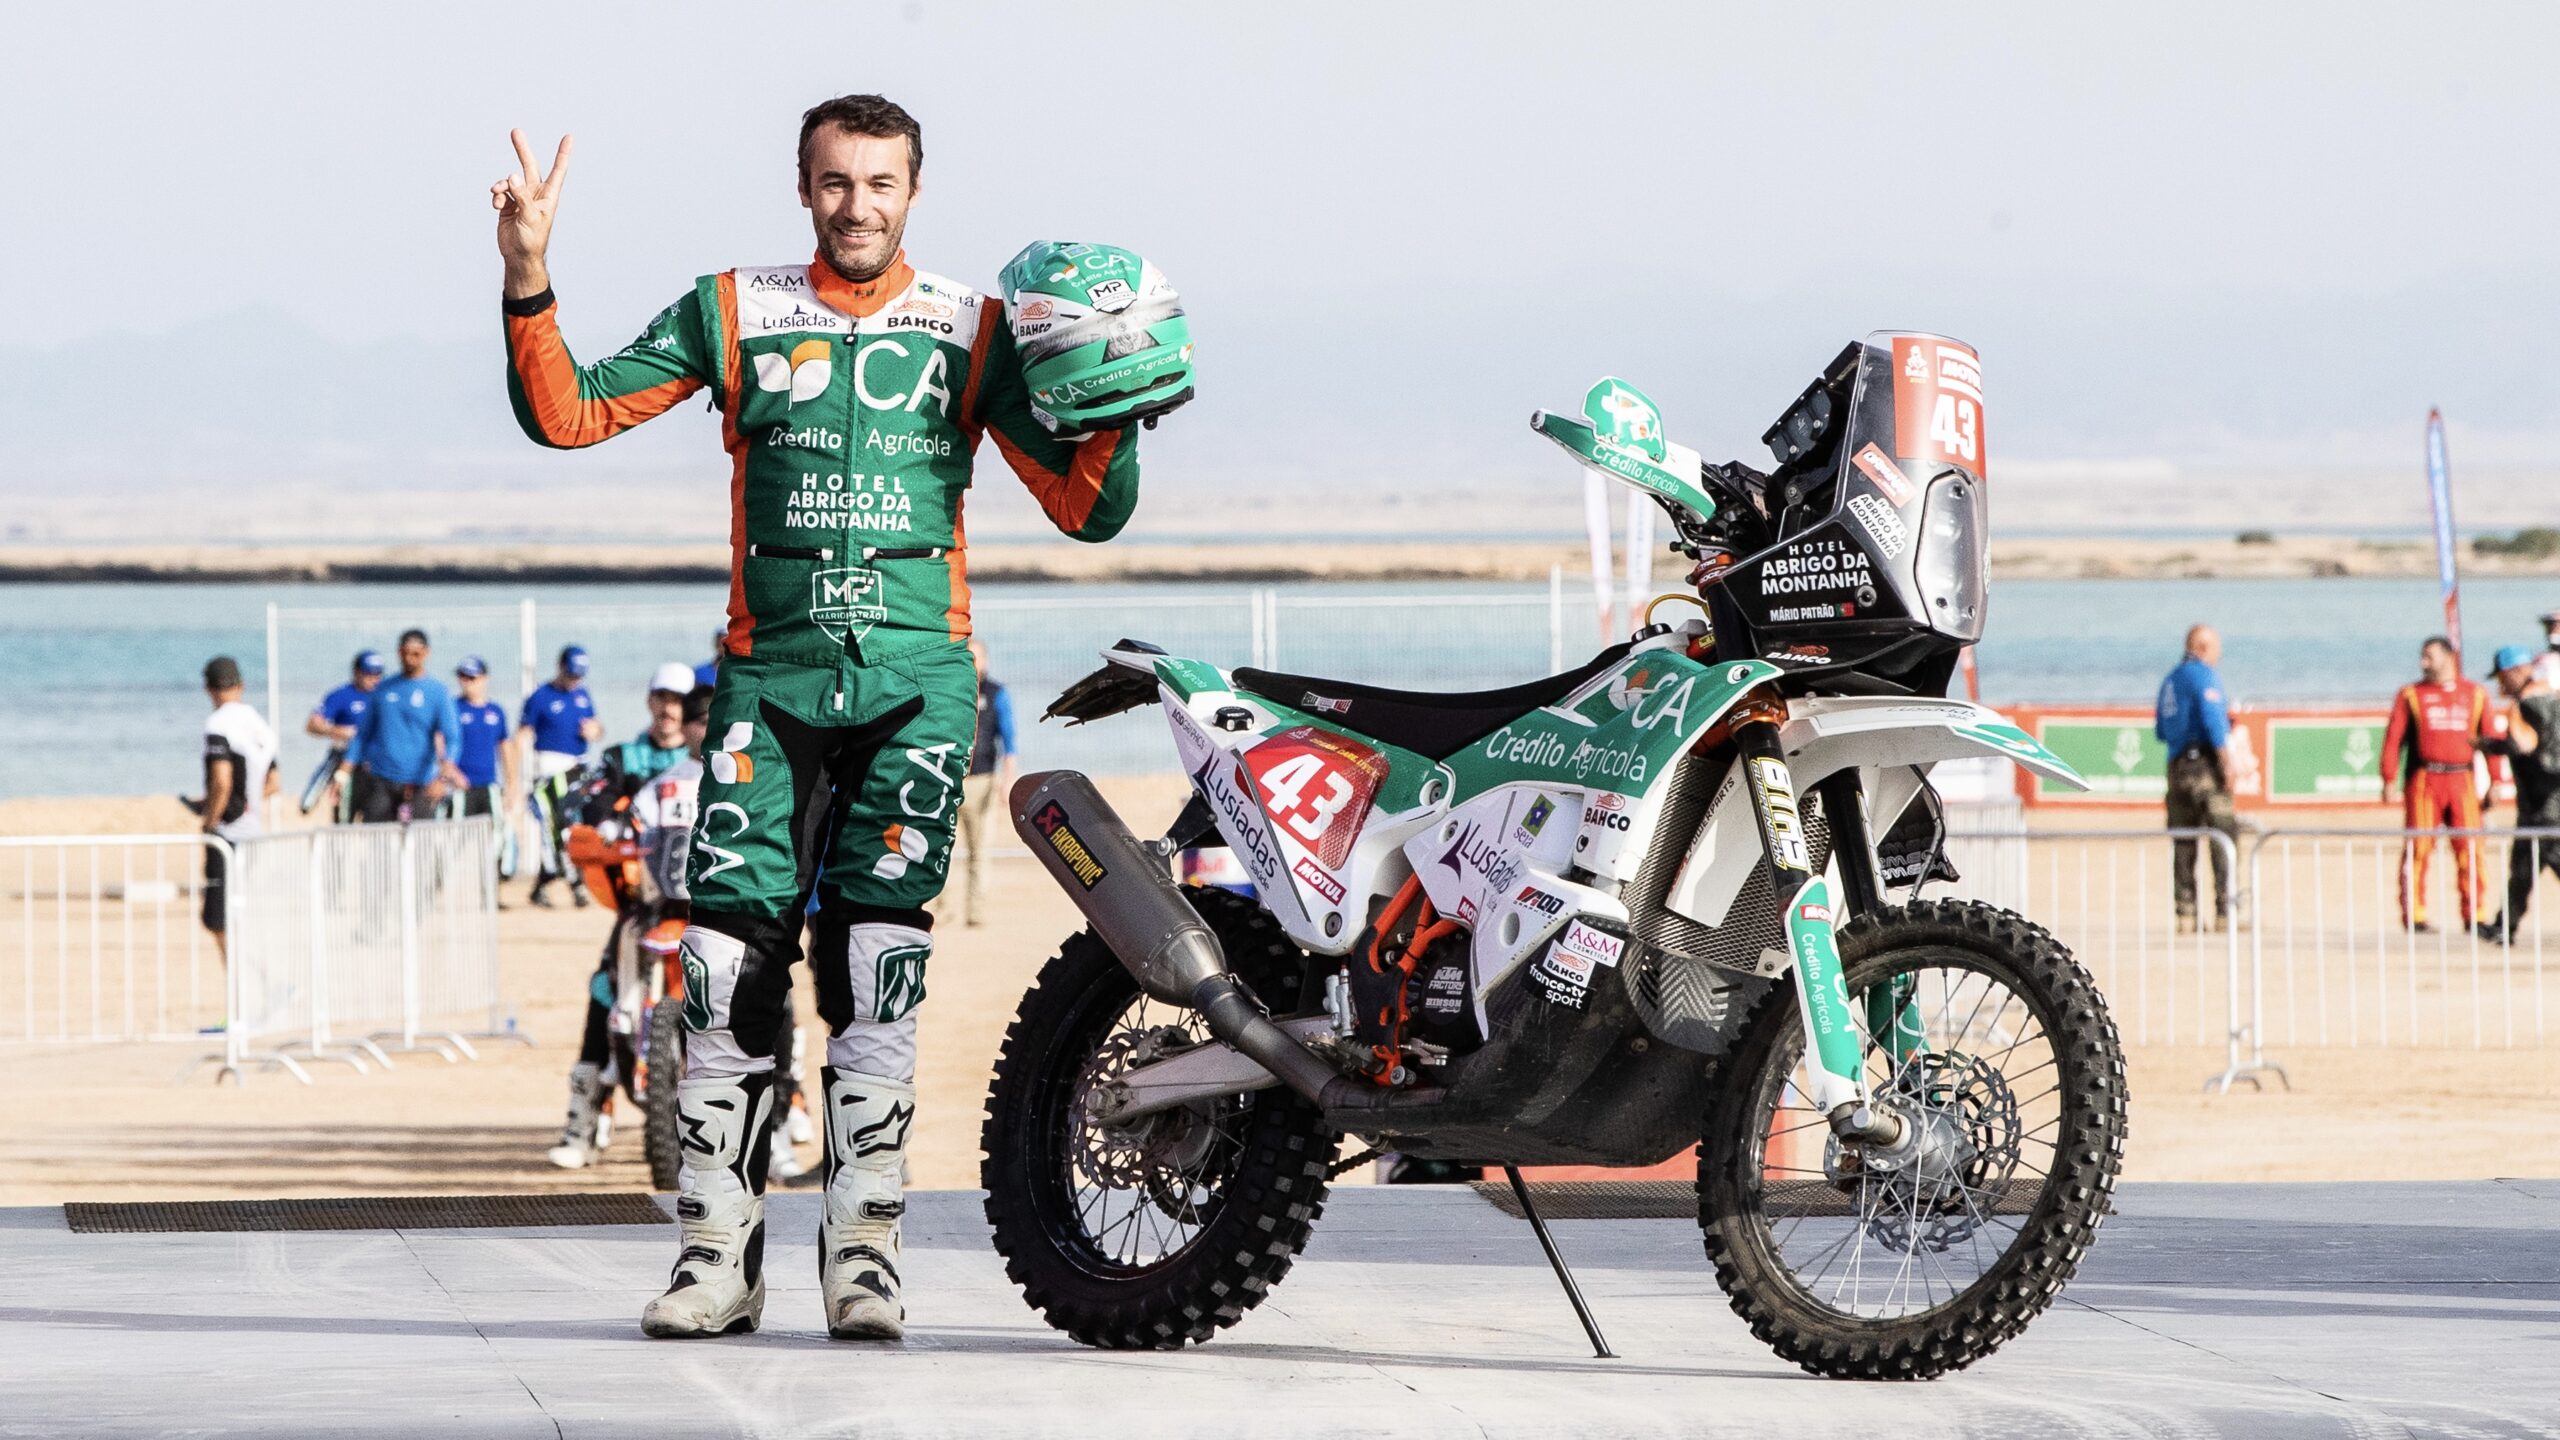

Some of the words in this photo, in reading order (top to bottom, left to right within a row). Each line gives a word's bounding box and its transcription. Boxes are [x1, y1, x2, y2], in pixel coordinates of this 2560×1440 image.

[750, 274, 805, 288] A&M
[1093, 281, 1122, 298] MP
[887, 316, 954, 335] BAHCO
[1020, 322, 1052, 337] BAHCO
[854, 339, 950, 418] CA
[1052, 382, 1090, 405] CA
[1084, 367, 1132, 389] Crédito
[1136, 351, 1178, 376] Agrícola
[768, 427, 842, 449] Crédito
[865, 428, 950, 456] Agrícola
[1930, 394, 1977, 462] 43
[802, 472, 905, 493] HOTEL
[1592, 444, 1643, 478] Crédito
[1642, 469, 1680, 496] Agrícola
[787, 491, 874, 510] ABRIGO
[881, 493, 912, 512] DA
[785, 511, 912, 532] MONTANHA
[1850, 501, 1894, 556] MONTANHA
[1861, 496, 1891, 533] ABRIGO
[1890, 535, 1902, 550] DA
[1789, 540, 1846, 556] HOTEL
[1761, 554, 1837, 578] ABRIGO
[1842, 552, 1870, 569] DA
[823, 576, 874, 604] MP
[1761, 570, 1873, 595] MONTANHA
[1770, 605, 1799, 622] MÁRIO
[1801, 603, 1835, 620] PATRÃO
[1765, 651, 1832, 665] BAHCO
[1632, 672, 1696, 738] CA
[1486, 726, 1565, 767] Crédito
[1564, 737, 1648, 783] Agrícola
[900, 742, 957, 820] CA
[1259, 753, 1354, 841] 43
[1206, 757, 1279, 879] Lusíadas
[1584, 807, 1631, 832] BAHCO
[697, 801, 750, 884] CA
[1461, 824, 1520, 894] Lusíadas
[1298, 862, 1345, 903] MOTUL
[1569, 926, 1618, 957] A&M
[1572, 943, 1608, 961] COSMETICA
[1434, 966, 1463, 980] KTM
[1546, 959, 1584, 982] BAHCO
[1802, 933, 1820, 980] Crédito
[1812, 984, 1832, 1034] Agrícola
[1428, 980, 1465, 990] FACTORY
[1545, 989, 1582, 1009] sport
